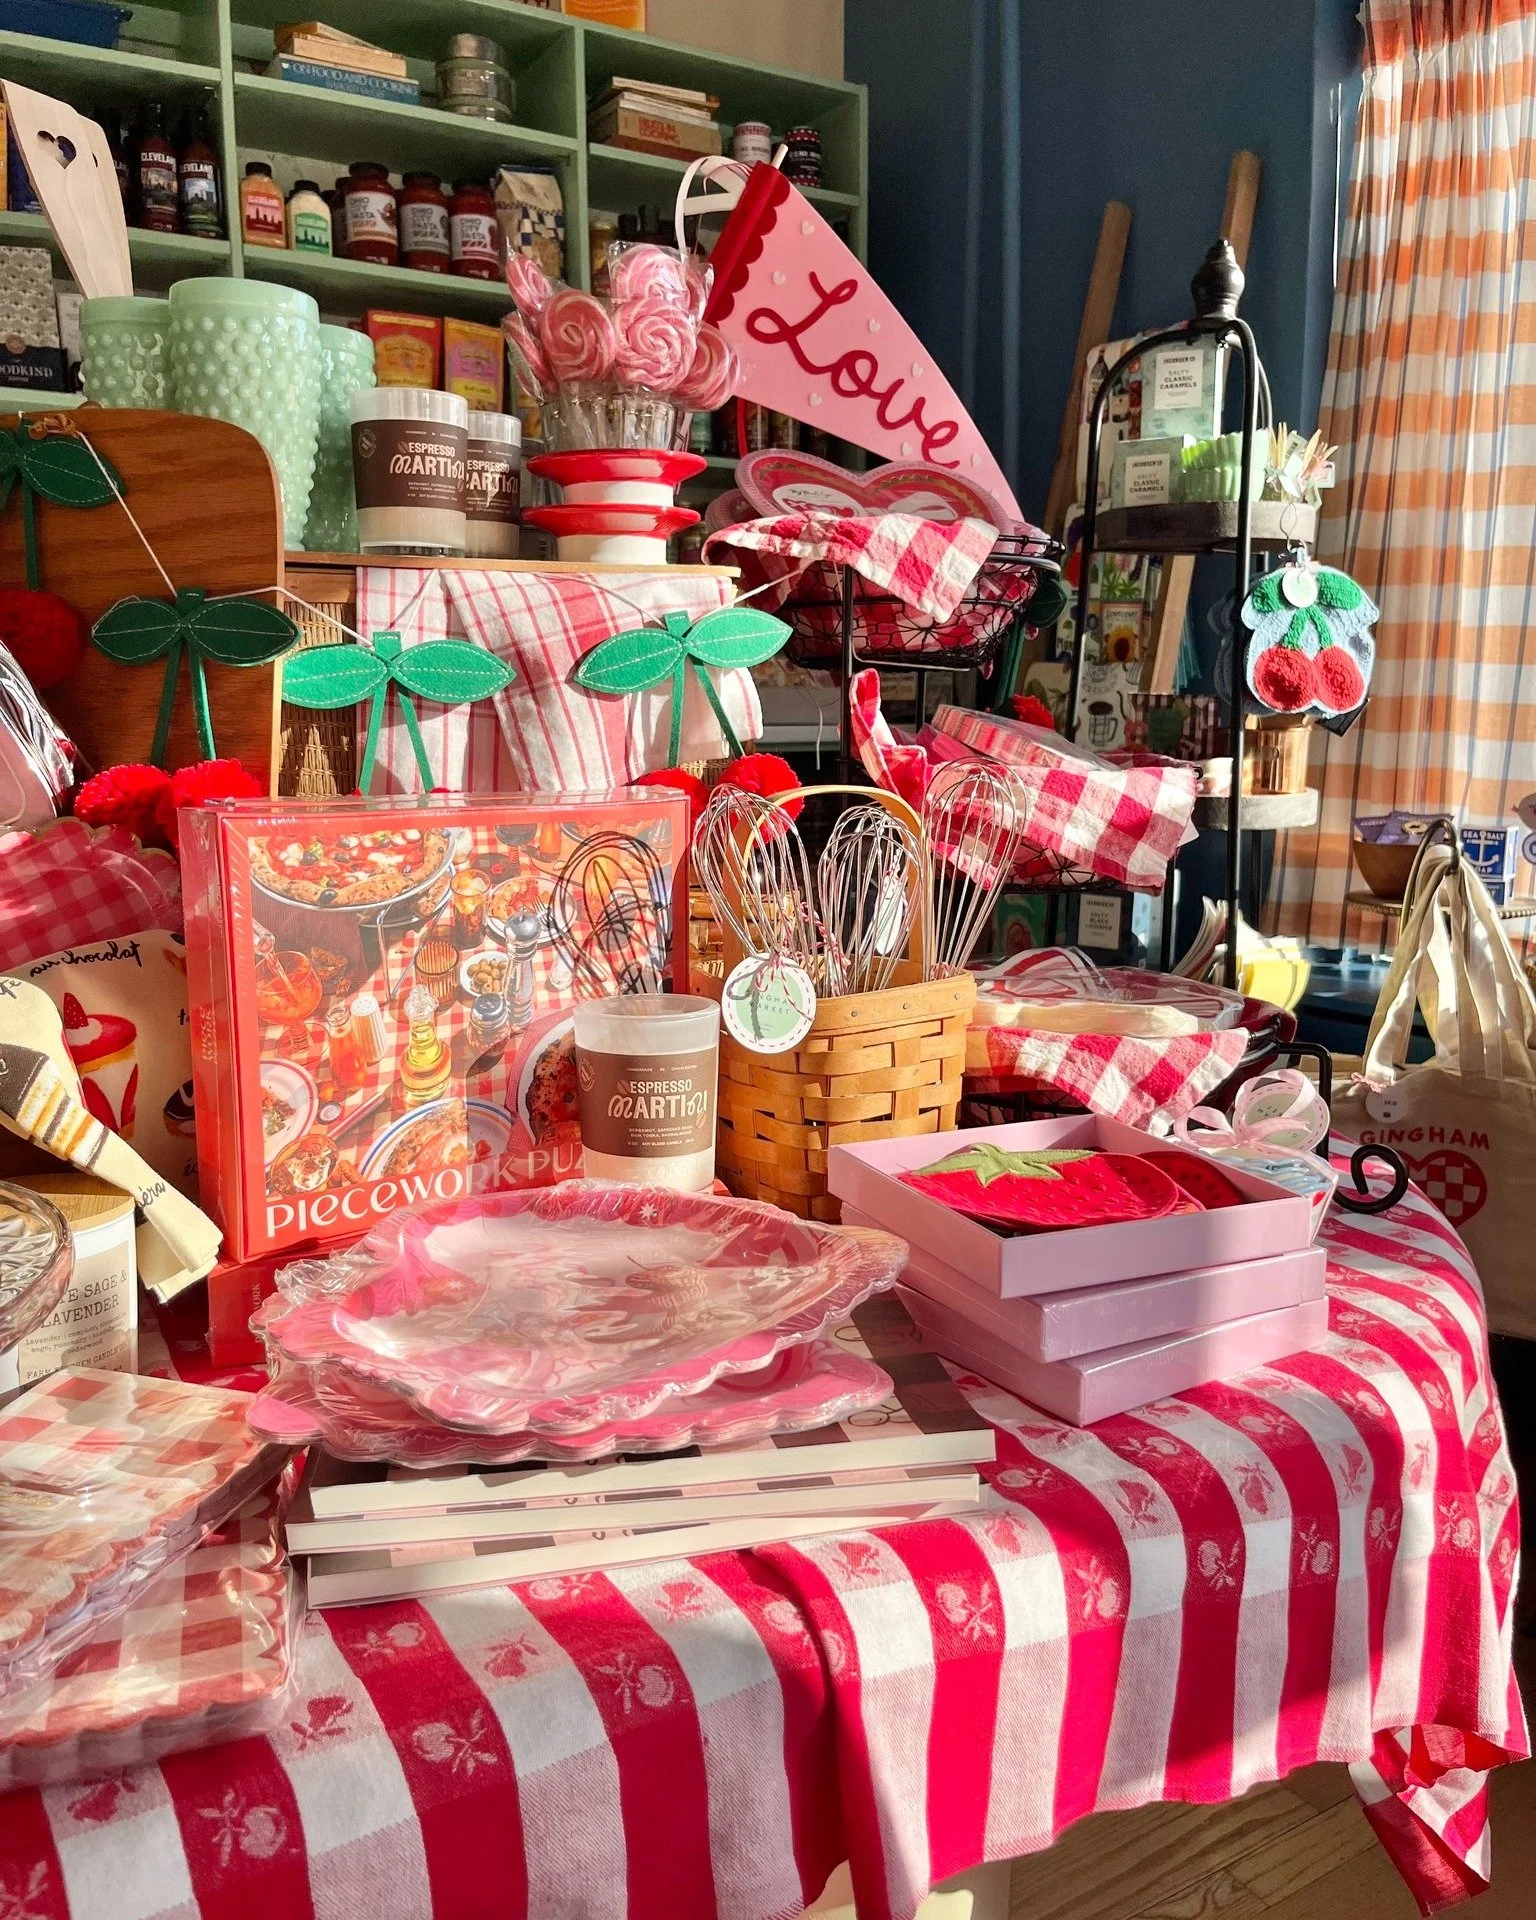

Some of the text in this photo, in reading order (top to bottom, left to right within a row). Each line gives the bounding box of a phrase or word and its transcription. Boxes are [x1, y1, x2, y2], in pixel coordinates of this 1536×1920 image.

[746, 271, 961, 469] Love
[1164, 375, 1193, 383] CLASSIC
[1160, 382, 1197, 390] CARAMELS
[408, 442, 456, 458] ESPRESSO
[390, 454, 465, 481] MARTINI
[466, 459, 510, 474] ESPRESSO
[466, 471, 518, 493] ARTINI
[1462, 830, 1505, 840] SEA SALT
[629, 1079, 693, 1095] ESPRESSO
[607, 1089, 708, 1119] MARTINI
[1360, 1126, 1490, 1150] GINGHAM
[84, 1275, 118, 1298] SAGE
[41, 1294, 120, 1328] LAVENDER
[26, 1334, 61, 1346] lavender
